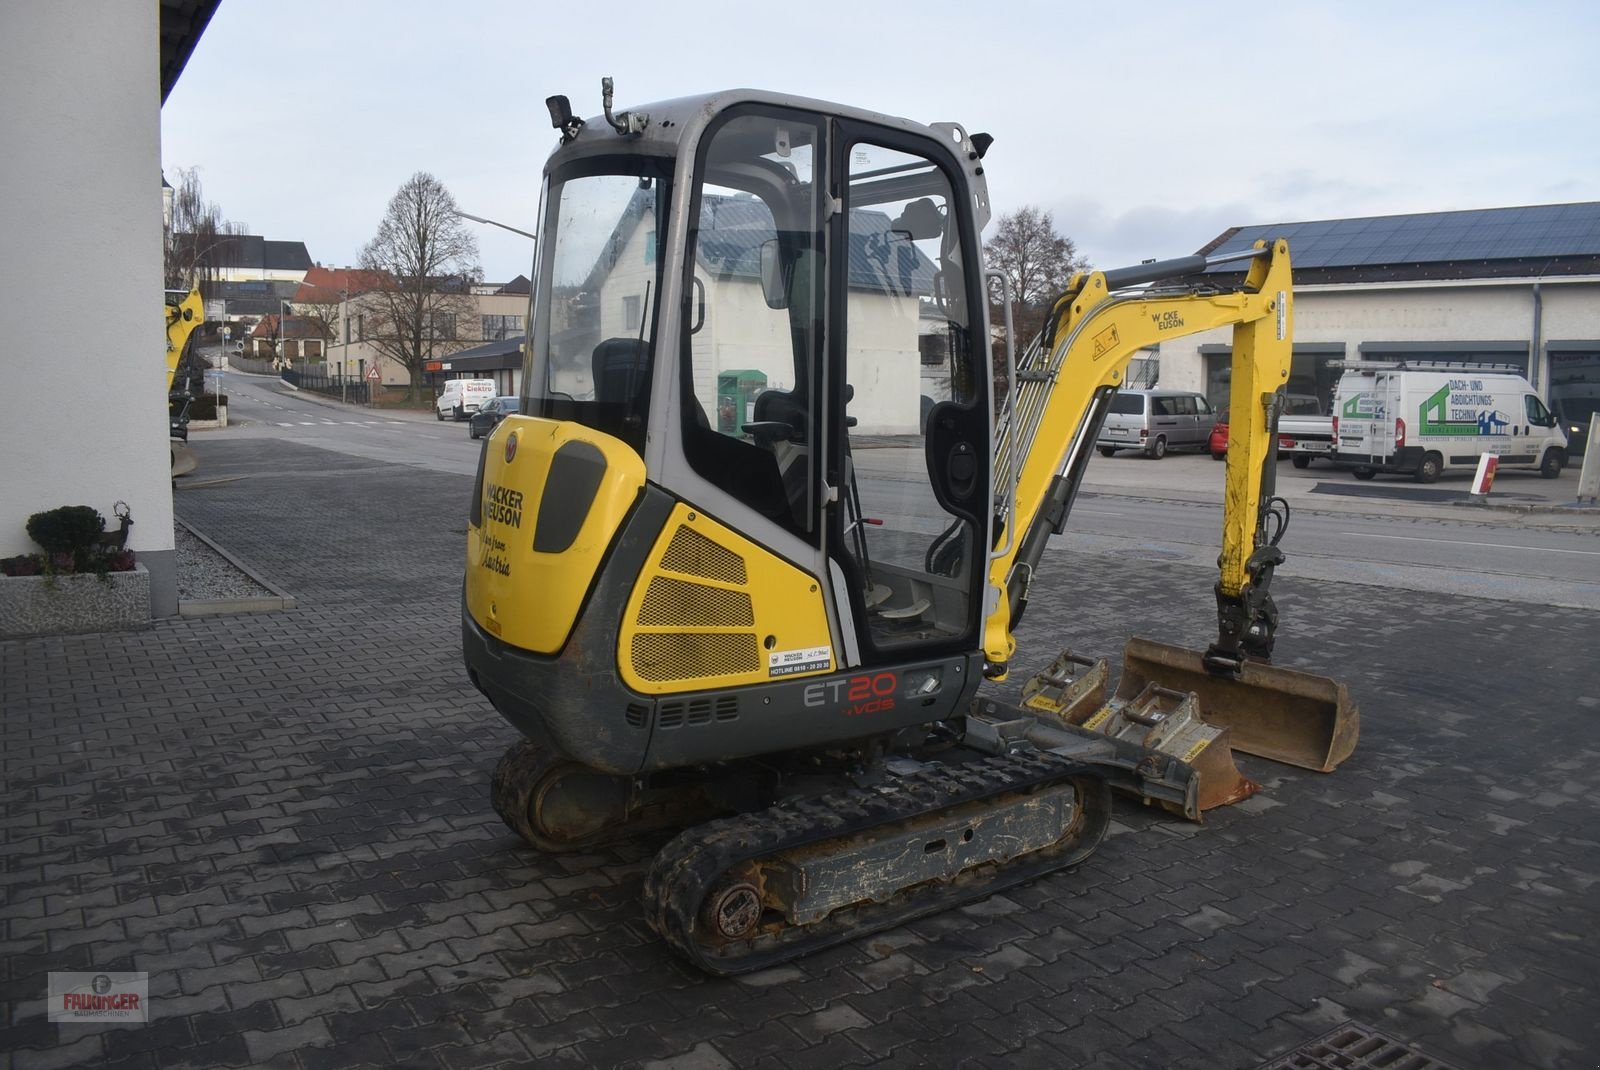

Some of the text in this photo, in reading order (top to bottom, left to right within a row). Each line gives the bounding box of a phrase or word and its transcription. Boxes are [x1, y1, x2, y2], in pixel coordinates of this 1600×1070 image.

[1449, 380, 1483, 391] DACH- UND
[1451, 409, 1477, 420] TECHNIK
[487, 482, 524, 511] WACKER
[484, 502, 522, 529] NEUSON
[770, 666, 793, 675] HOTLINE
